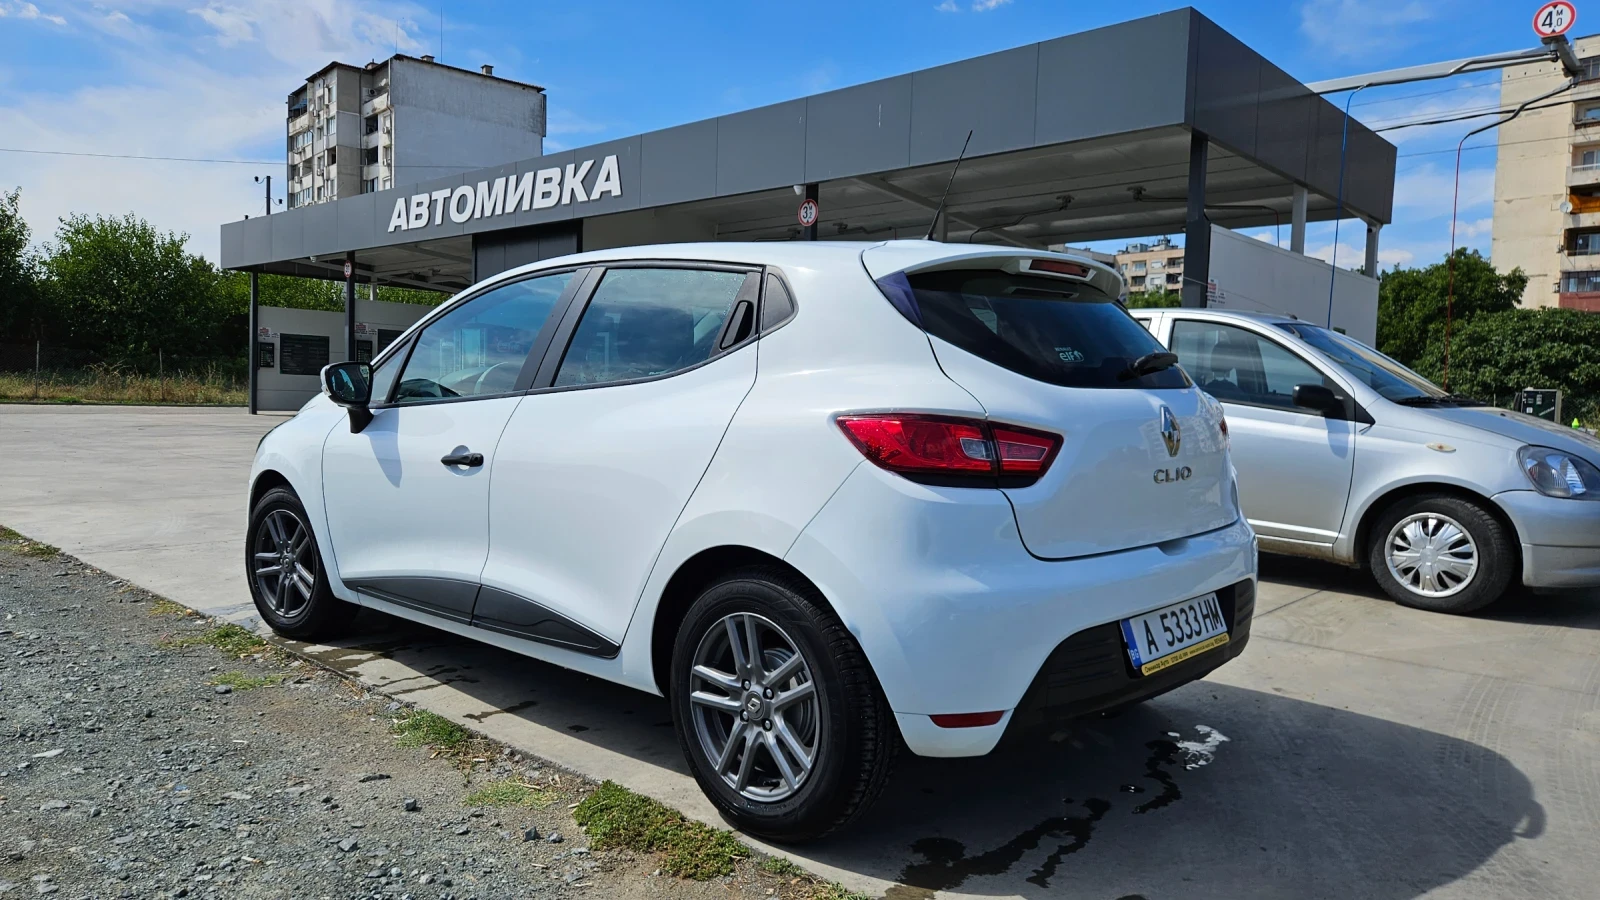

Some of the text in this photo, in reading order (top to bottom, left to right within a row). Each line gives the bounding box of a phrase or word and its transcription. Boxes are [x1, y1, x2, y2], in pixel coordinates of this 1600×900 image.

[387, 154, 622, 233] АВТОМИВКА
[1153, 465, 1192, 484] CLIO
[1130, 648, 1140, 661] BG
